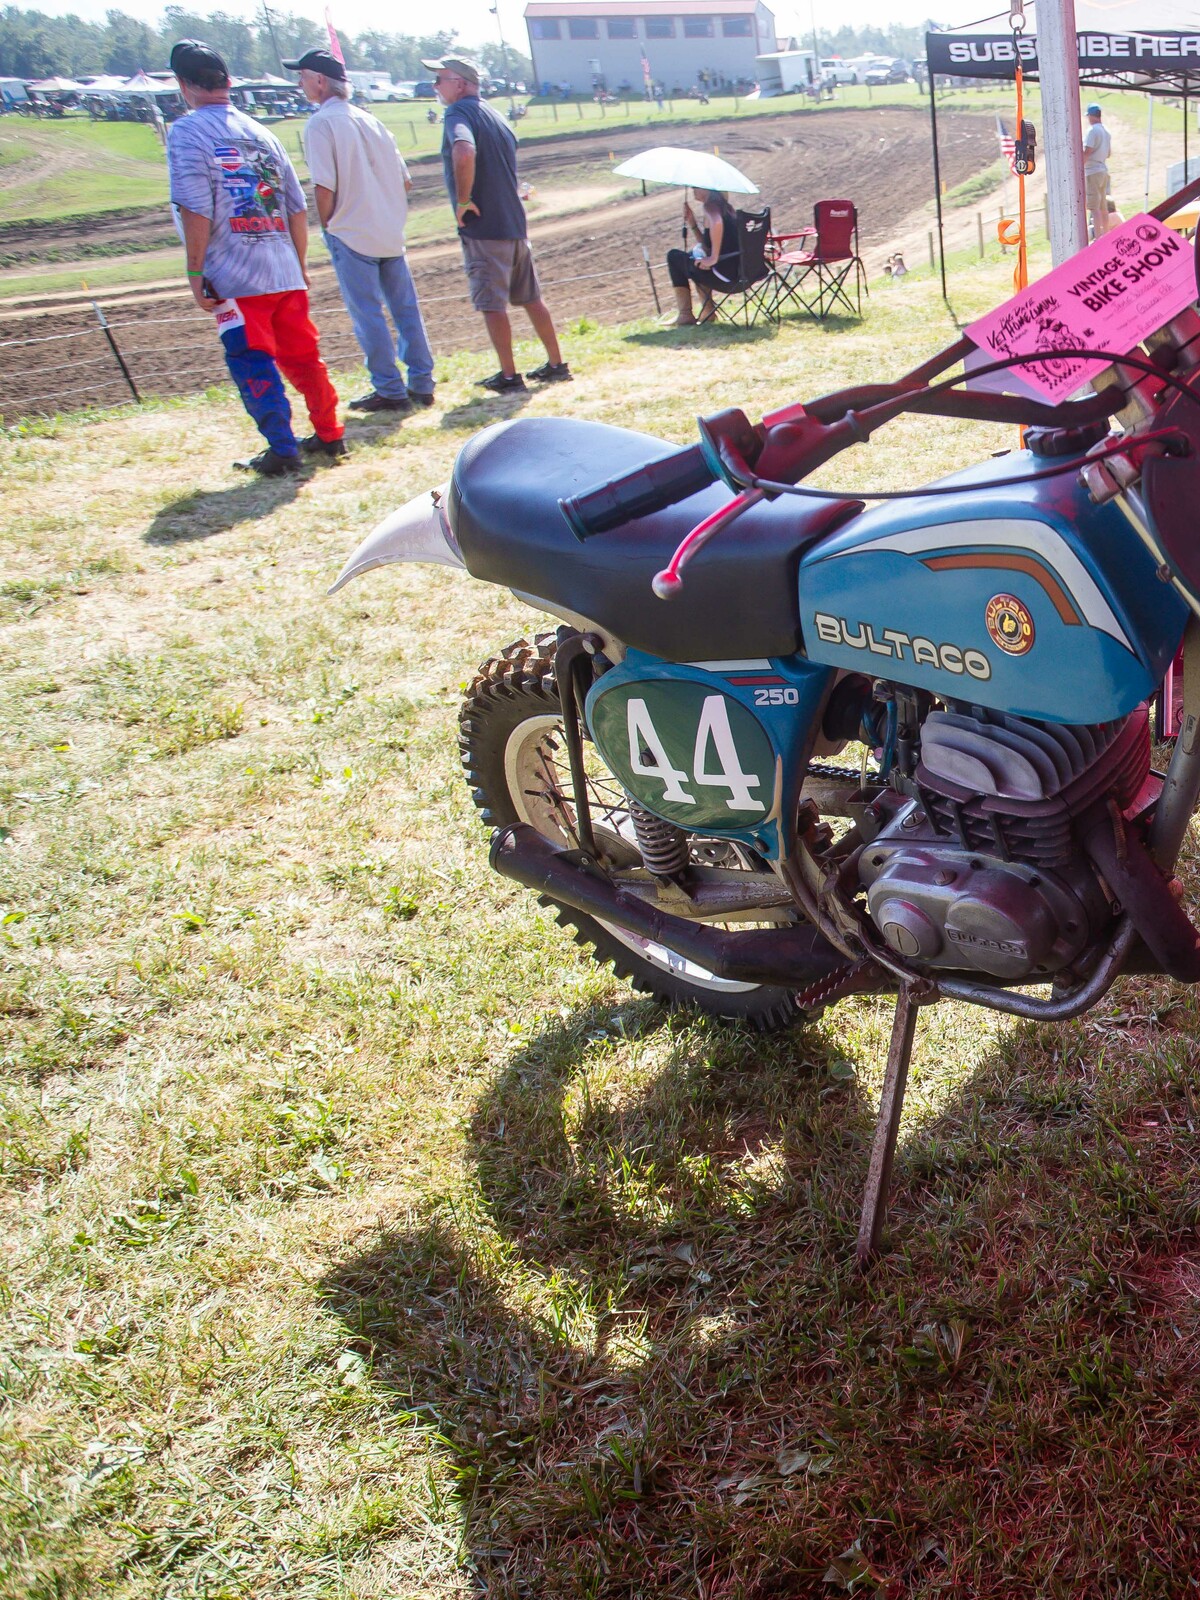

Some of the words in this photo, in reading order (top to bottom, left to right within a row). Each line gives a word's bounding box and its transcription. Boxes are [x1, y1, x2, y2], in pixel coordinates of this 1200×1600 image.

[948, 36, 1130, 62] SUBSIBE
[1066, 256, 1126, 297] VINTAGE
[1082, 277, 1126, 313] BIKE
[1122, 236, 1181, 284] SHOW
[988, 597, 1031, 636] BULTACO
[814, 611, 992, 682] BULTACO
[753, 687, 800, 707] 250
[627, 695, 765, 811] 44
[947, 928, 1027, 958] BULTACO
